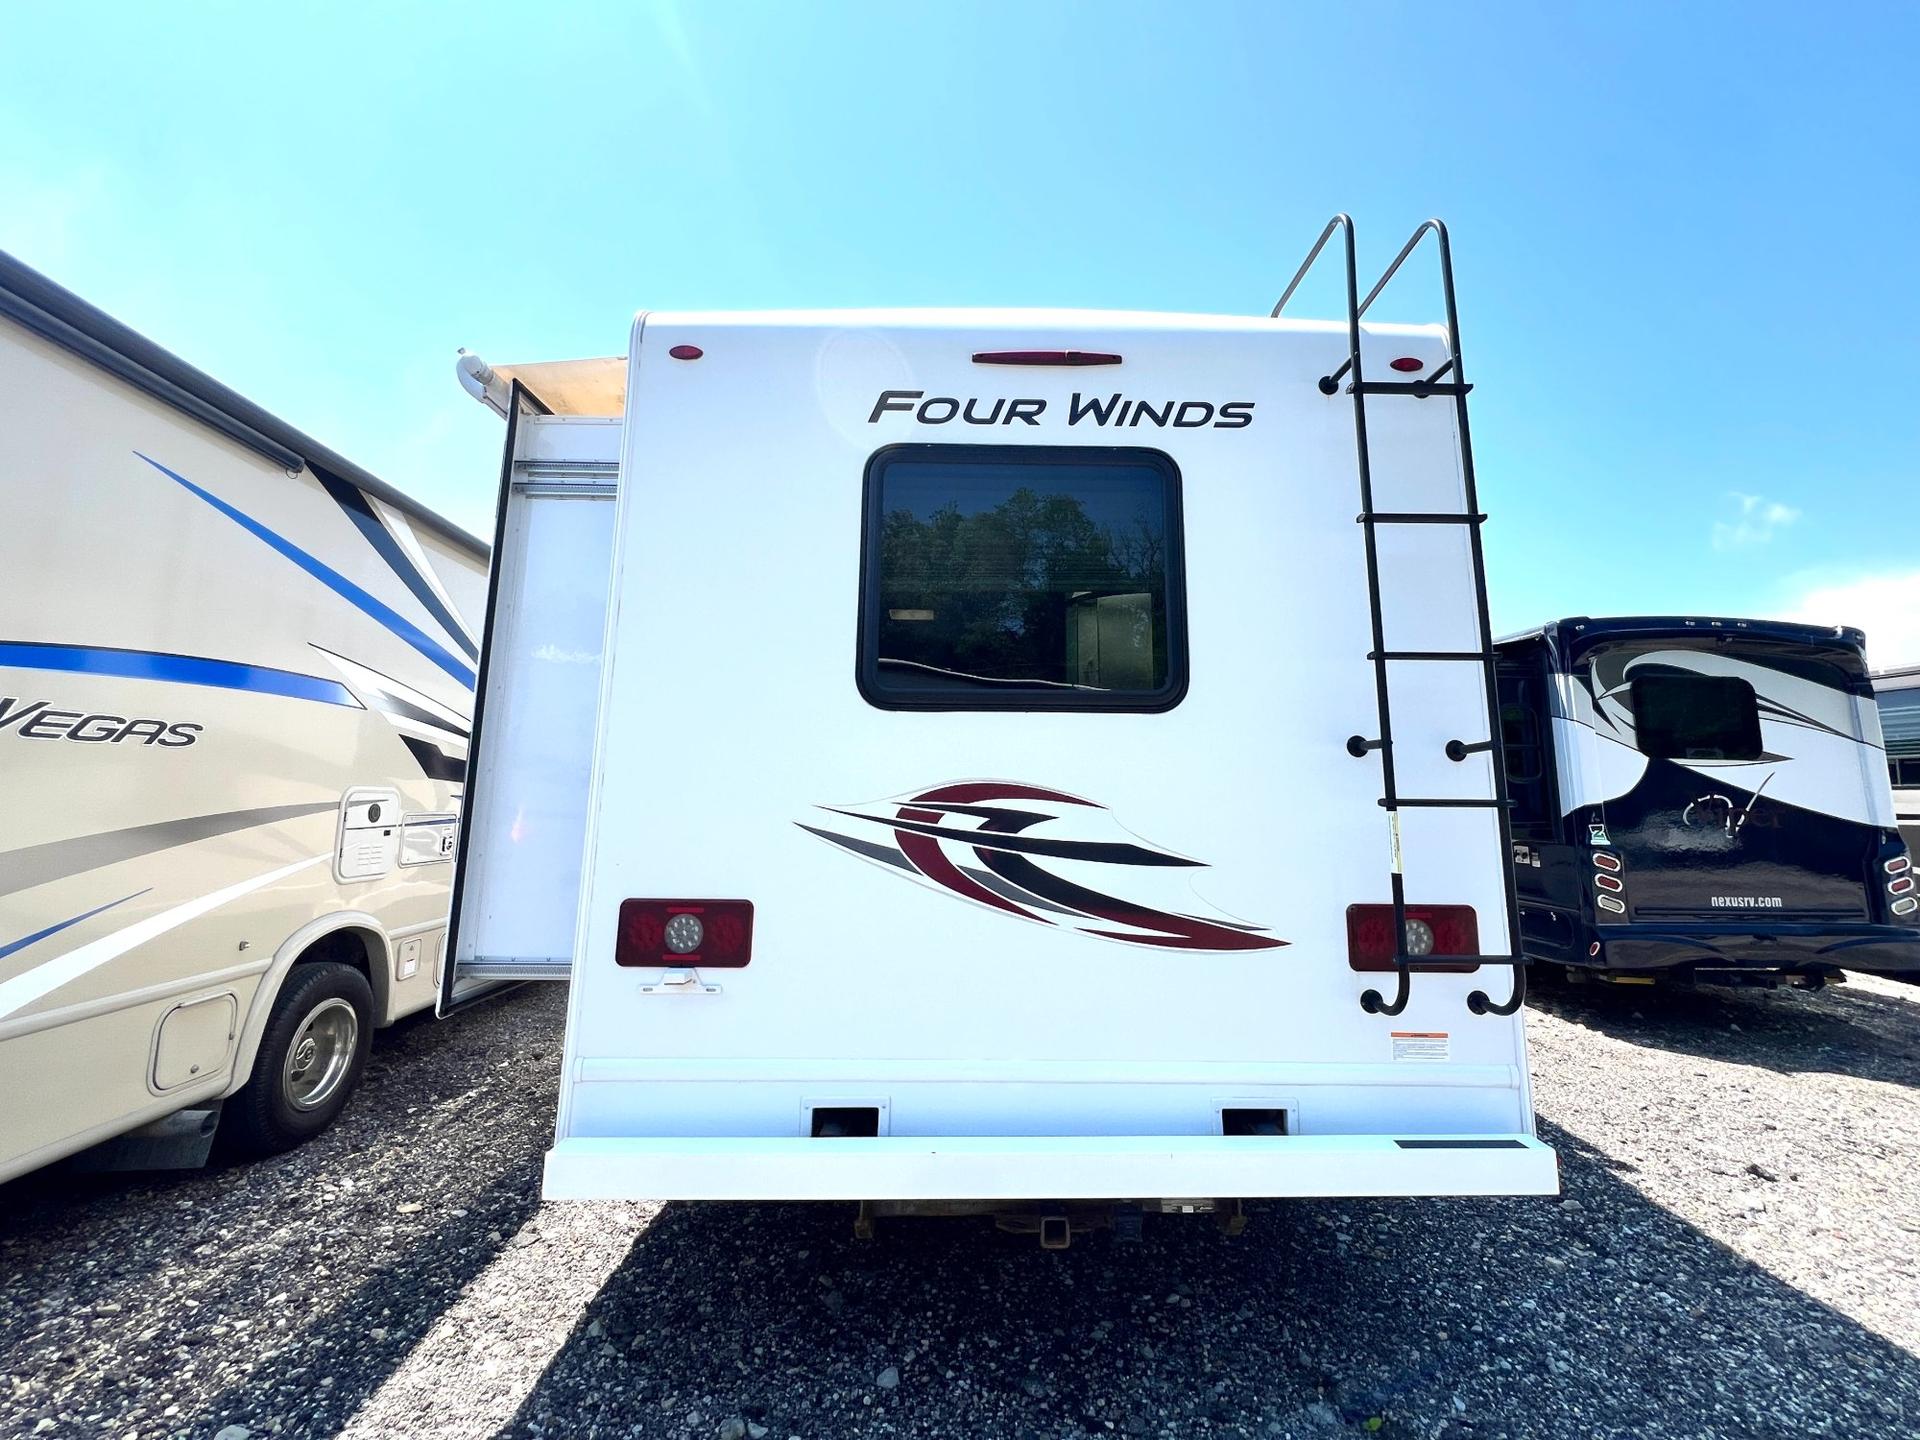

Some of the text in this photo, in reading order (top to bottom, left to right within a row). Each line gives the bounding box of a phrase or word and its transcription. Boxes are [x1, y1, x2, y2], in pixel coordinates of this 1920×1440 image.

[867, 390, 1255, 428] FOUR WINDS
[1711, 896, 1783, 908] nexusrv.com
